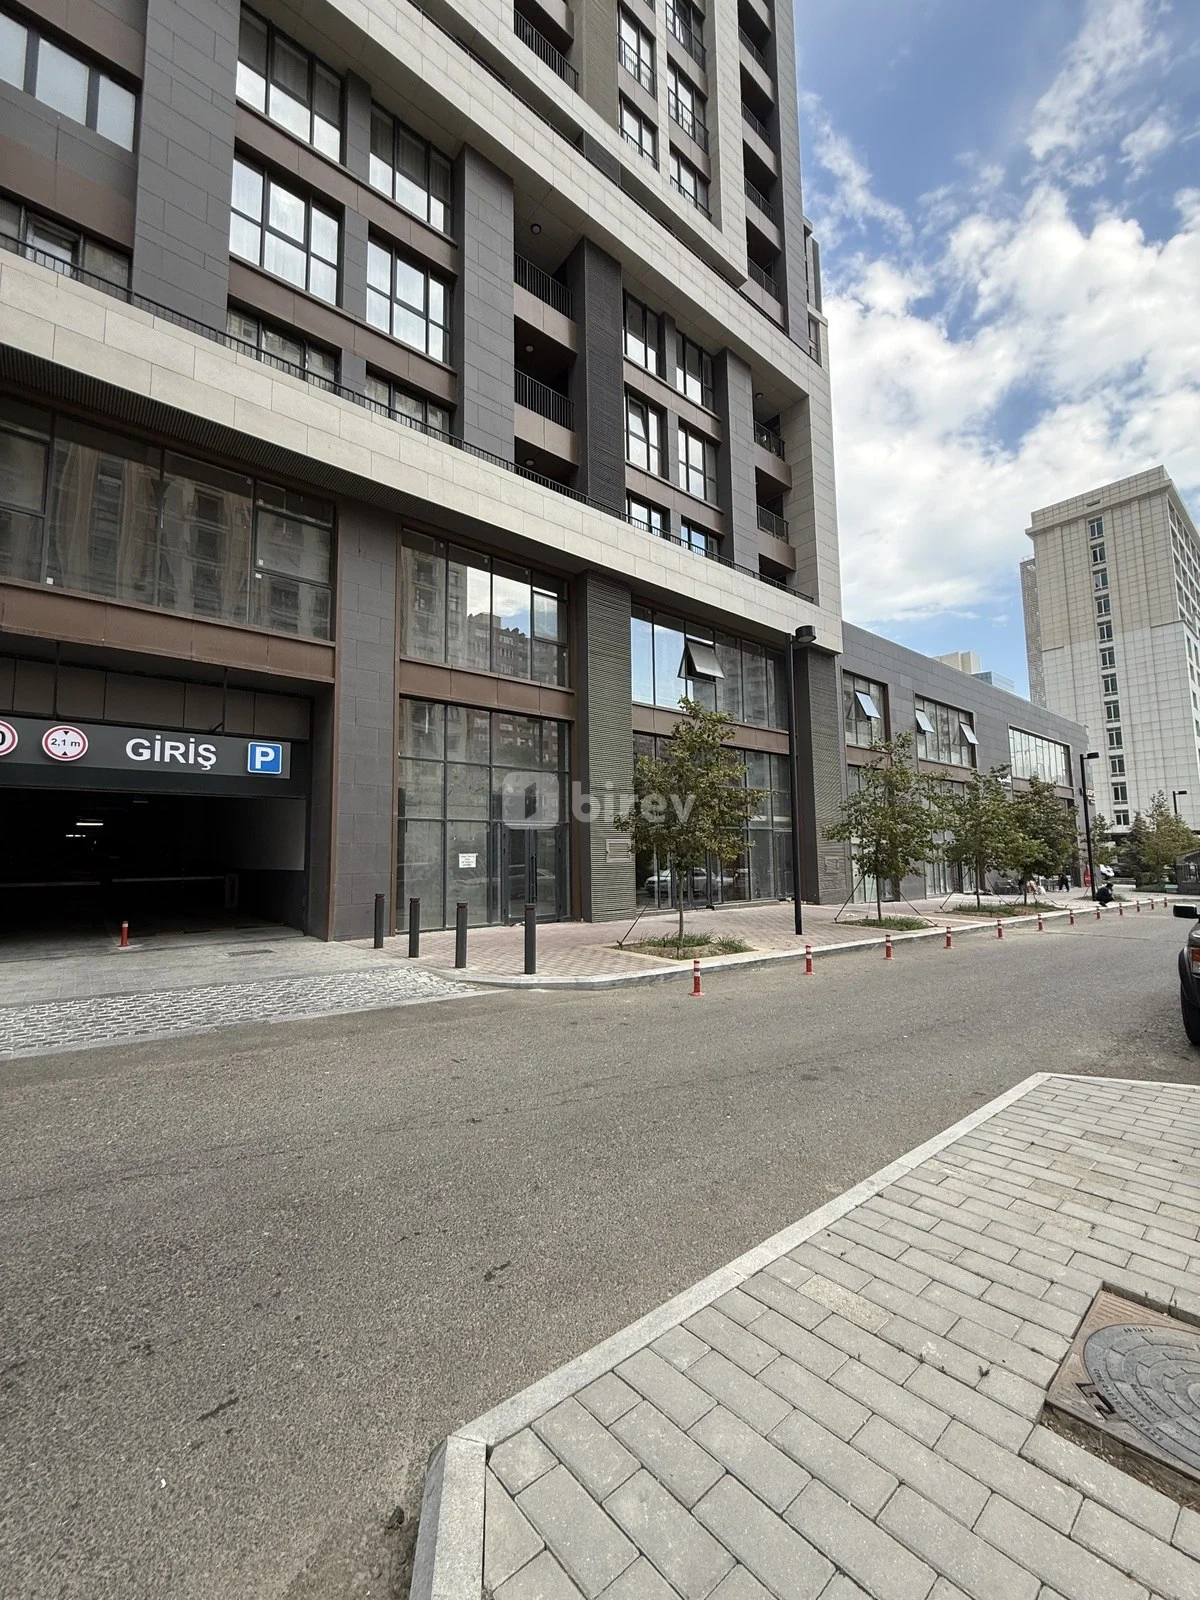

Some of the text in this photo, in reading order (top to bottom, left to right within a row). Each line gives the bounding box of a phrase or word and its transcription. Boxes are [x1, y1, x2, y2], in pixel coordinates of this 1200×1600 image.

[51, 738, 81, 748] 2,1 m
[125, 735, 217, 771] GİRİŞ
[255, 747, 275, 769] P
